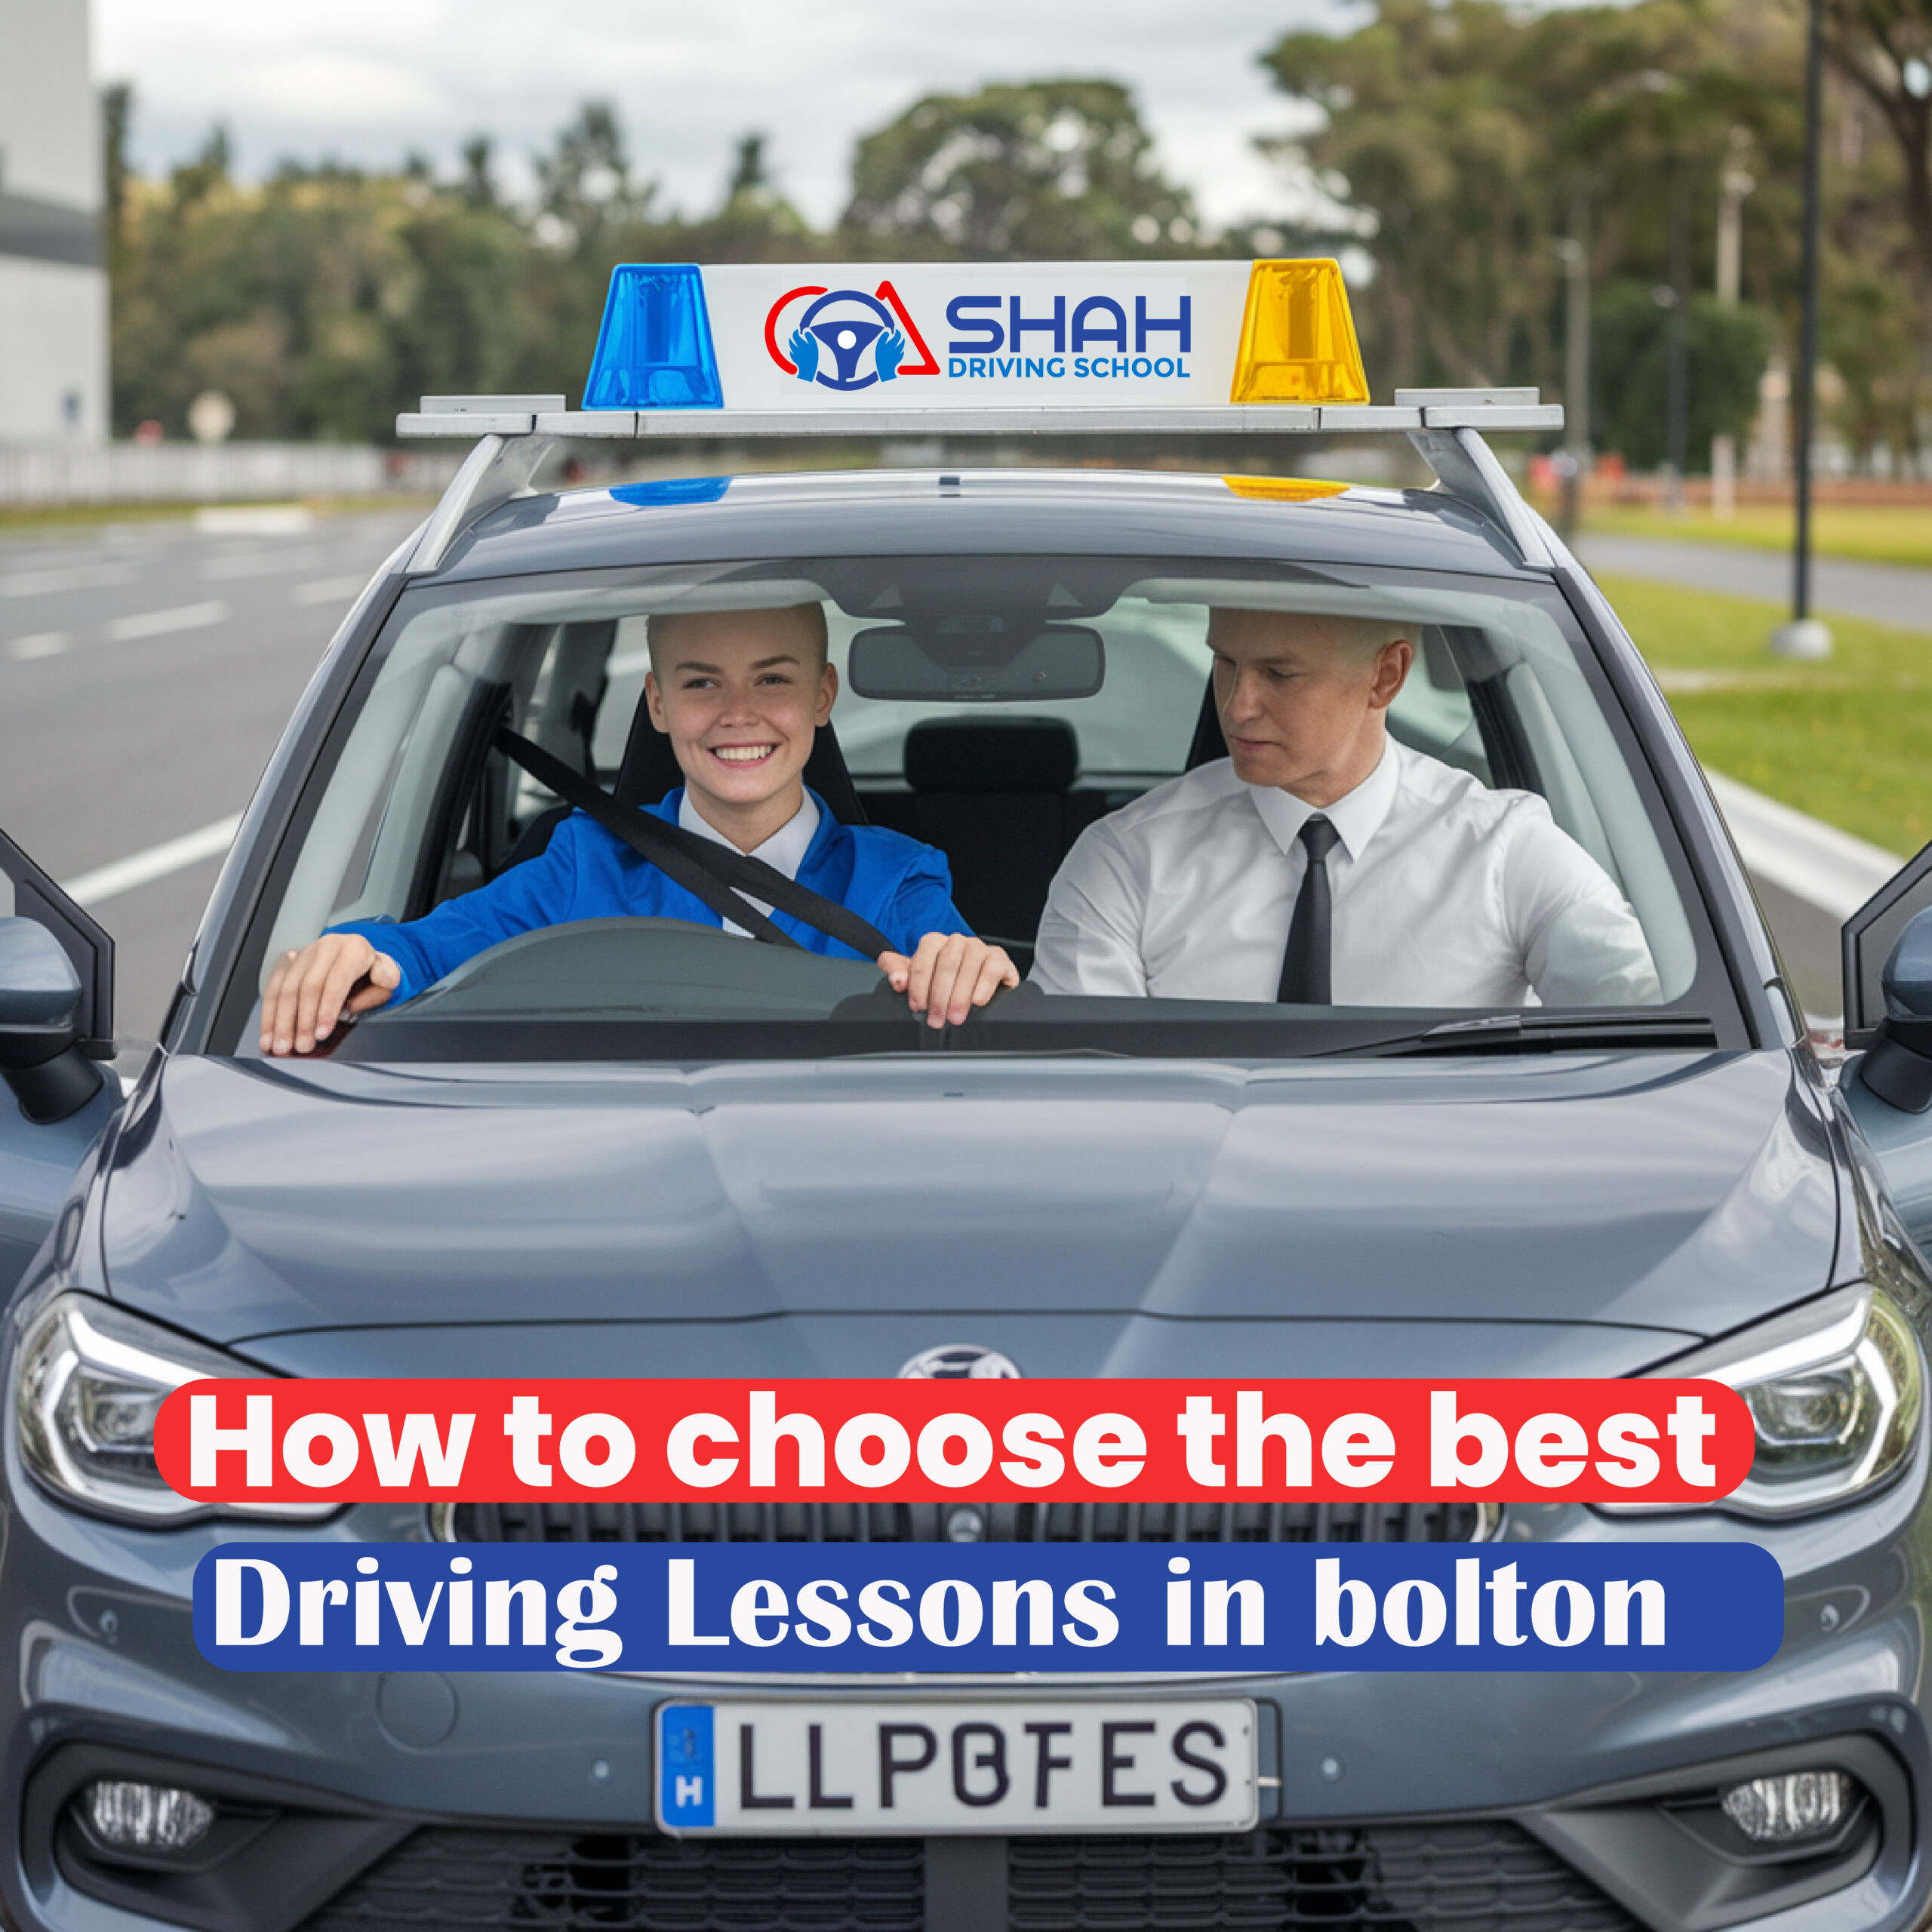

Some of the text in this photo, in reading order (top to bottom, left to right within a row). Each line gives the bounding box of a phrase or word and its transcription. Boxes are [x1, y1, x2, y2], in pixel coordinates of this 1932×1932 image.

[946, 295, 1192, 354] SHAH
[948, 356, 1192, 379] DRIVING SCHOOL
